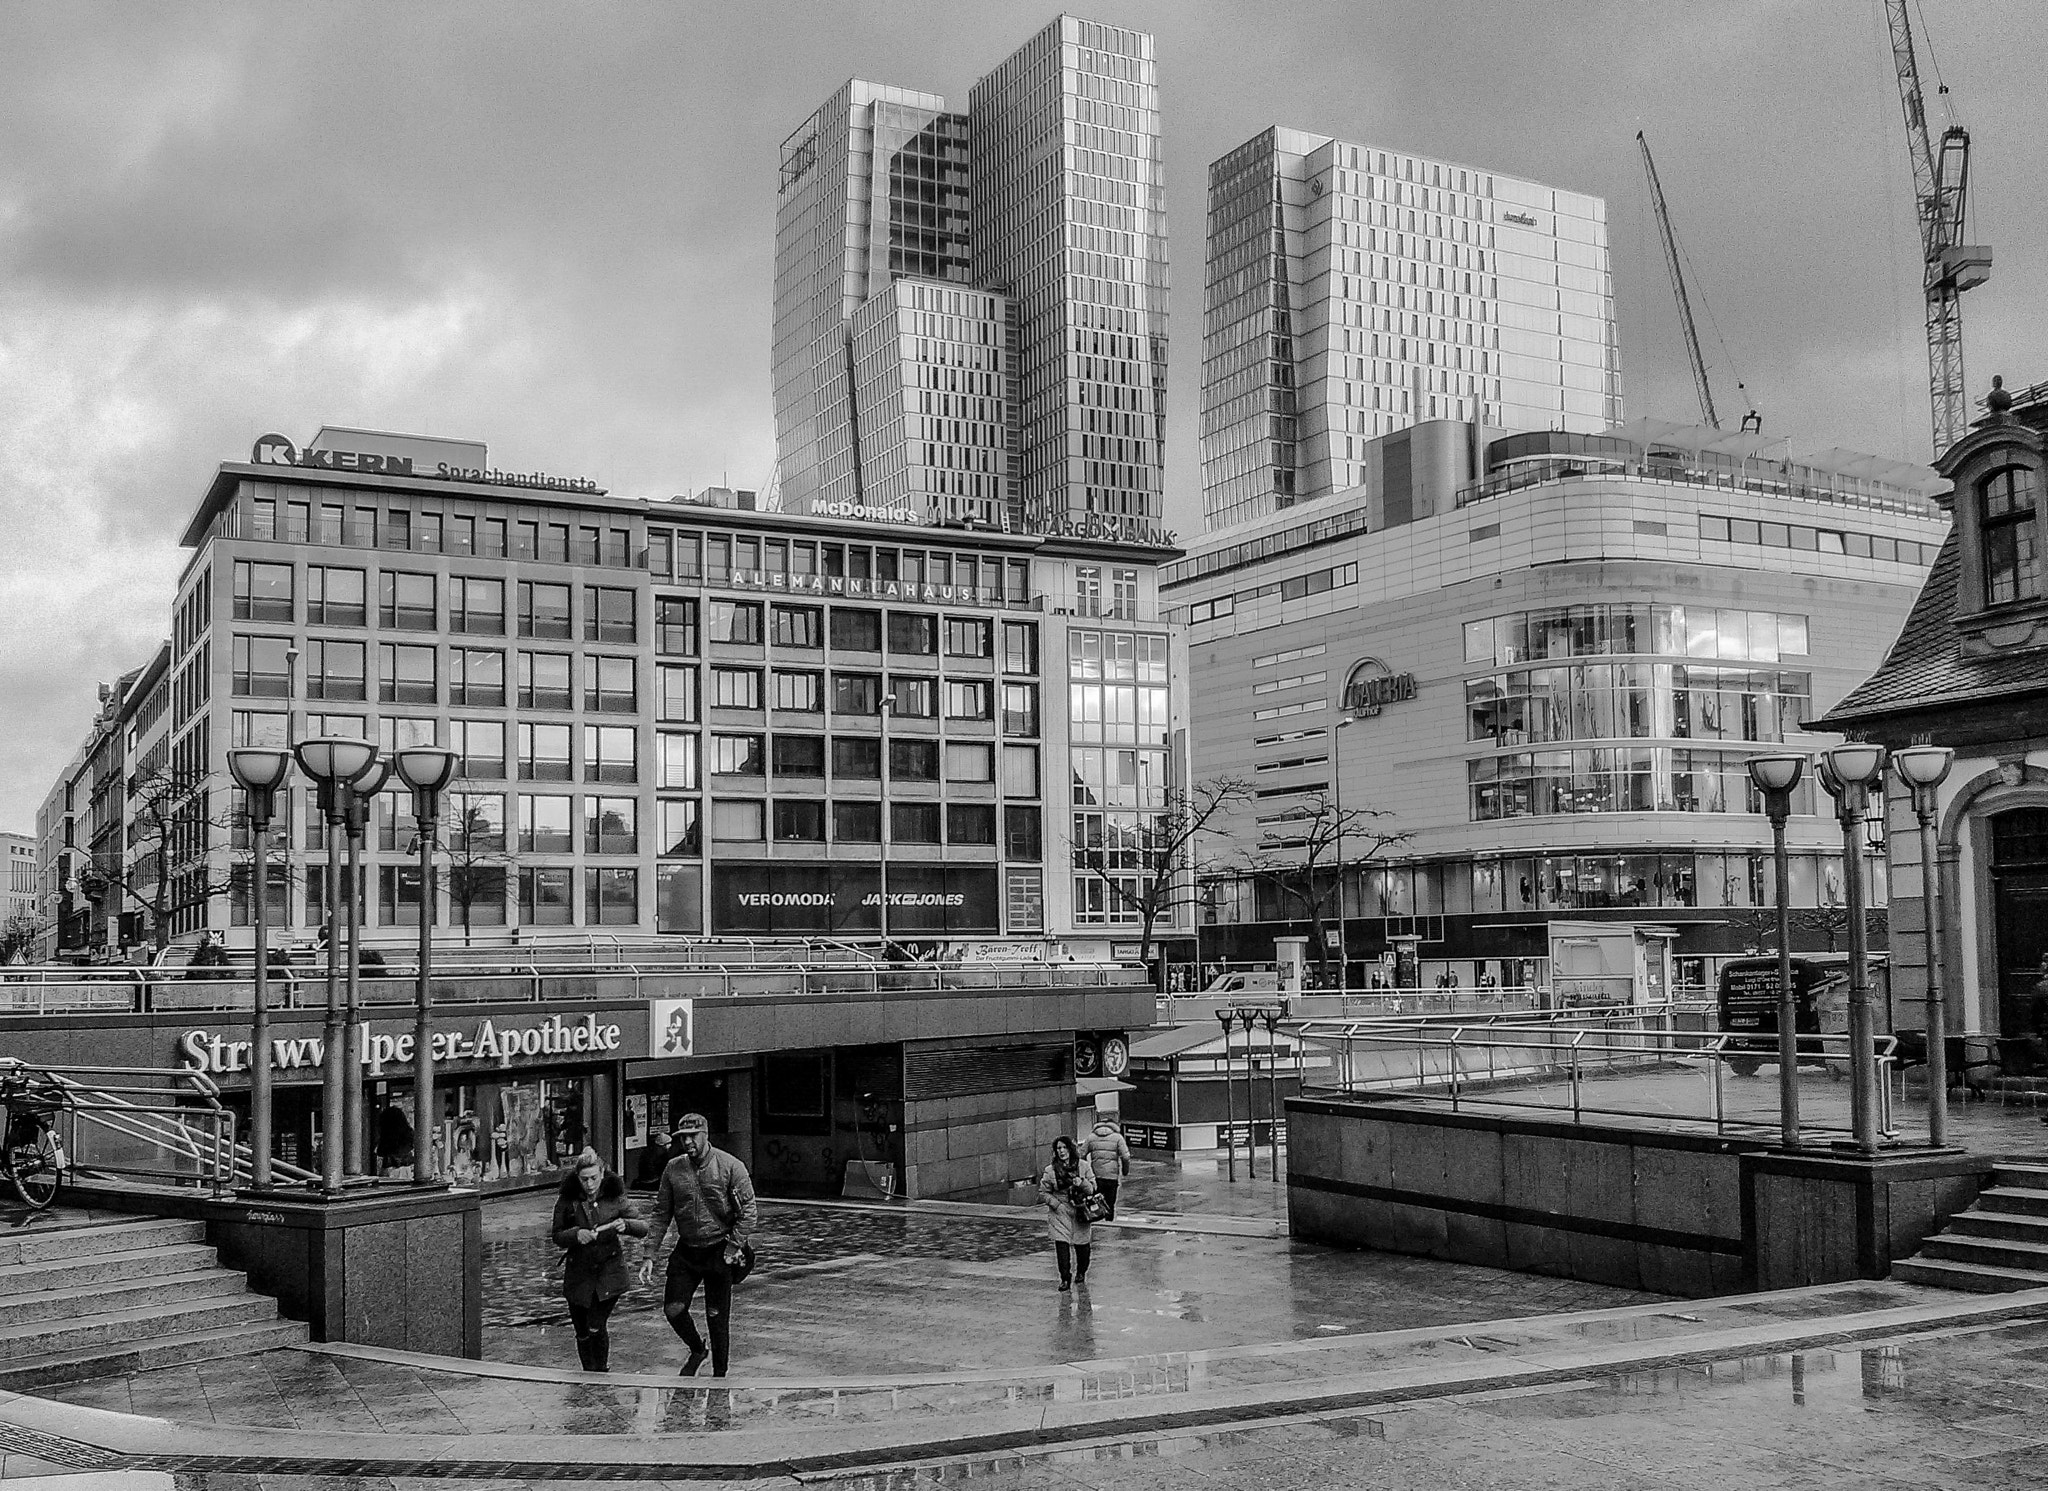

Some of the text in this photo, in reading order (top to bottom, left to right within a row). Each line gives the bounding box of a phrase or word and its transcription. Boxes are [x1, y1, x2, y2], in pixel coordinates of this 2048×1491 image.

[302, 448, 413, 476] KERN
[437, 462, 598, 490] Sprachendienste
[811, 500, 918, 522] McDonald's
[732, 571, 969, 600] ALEMANNIAHAUS
